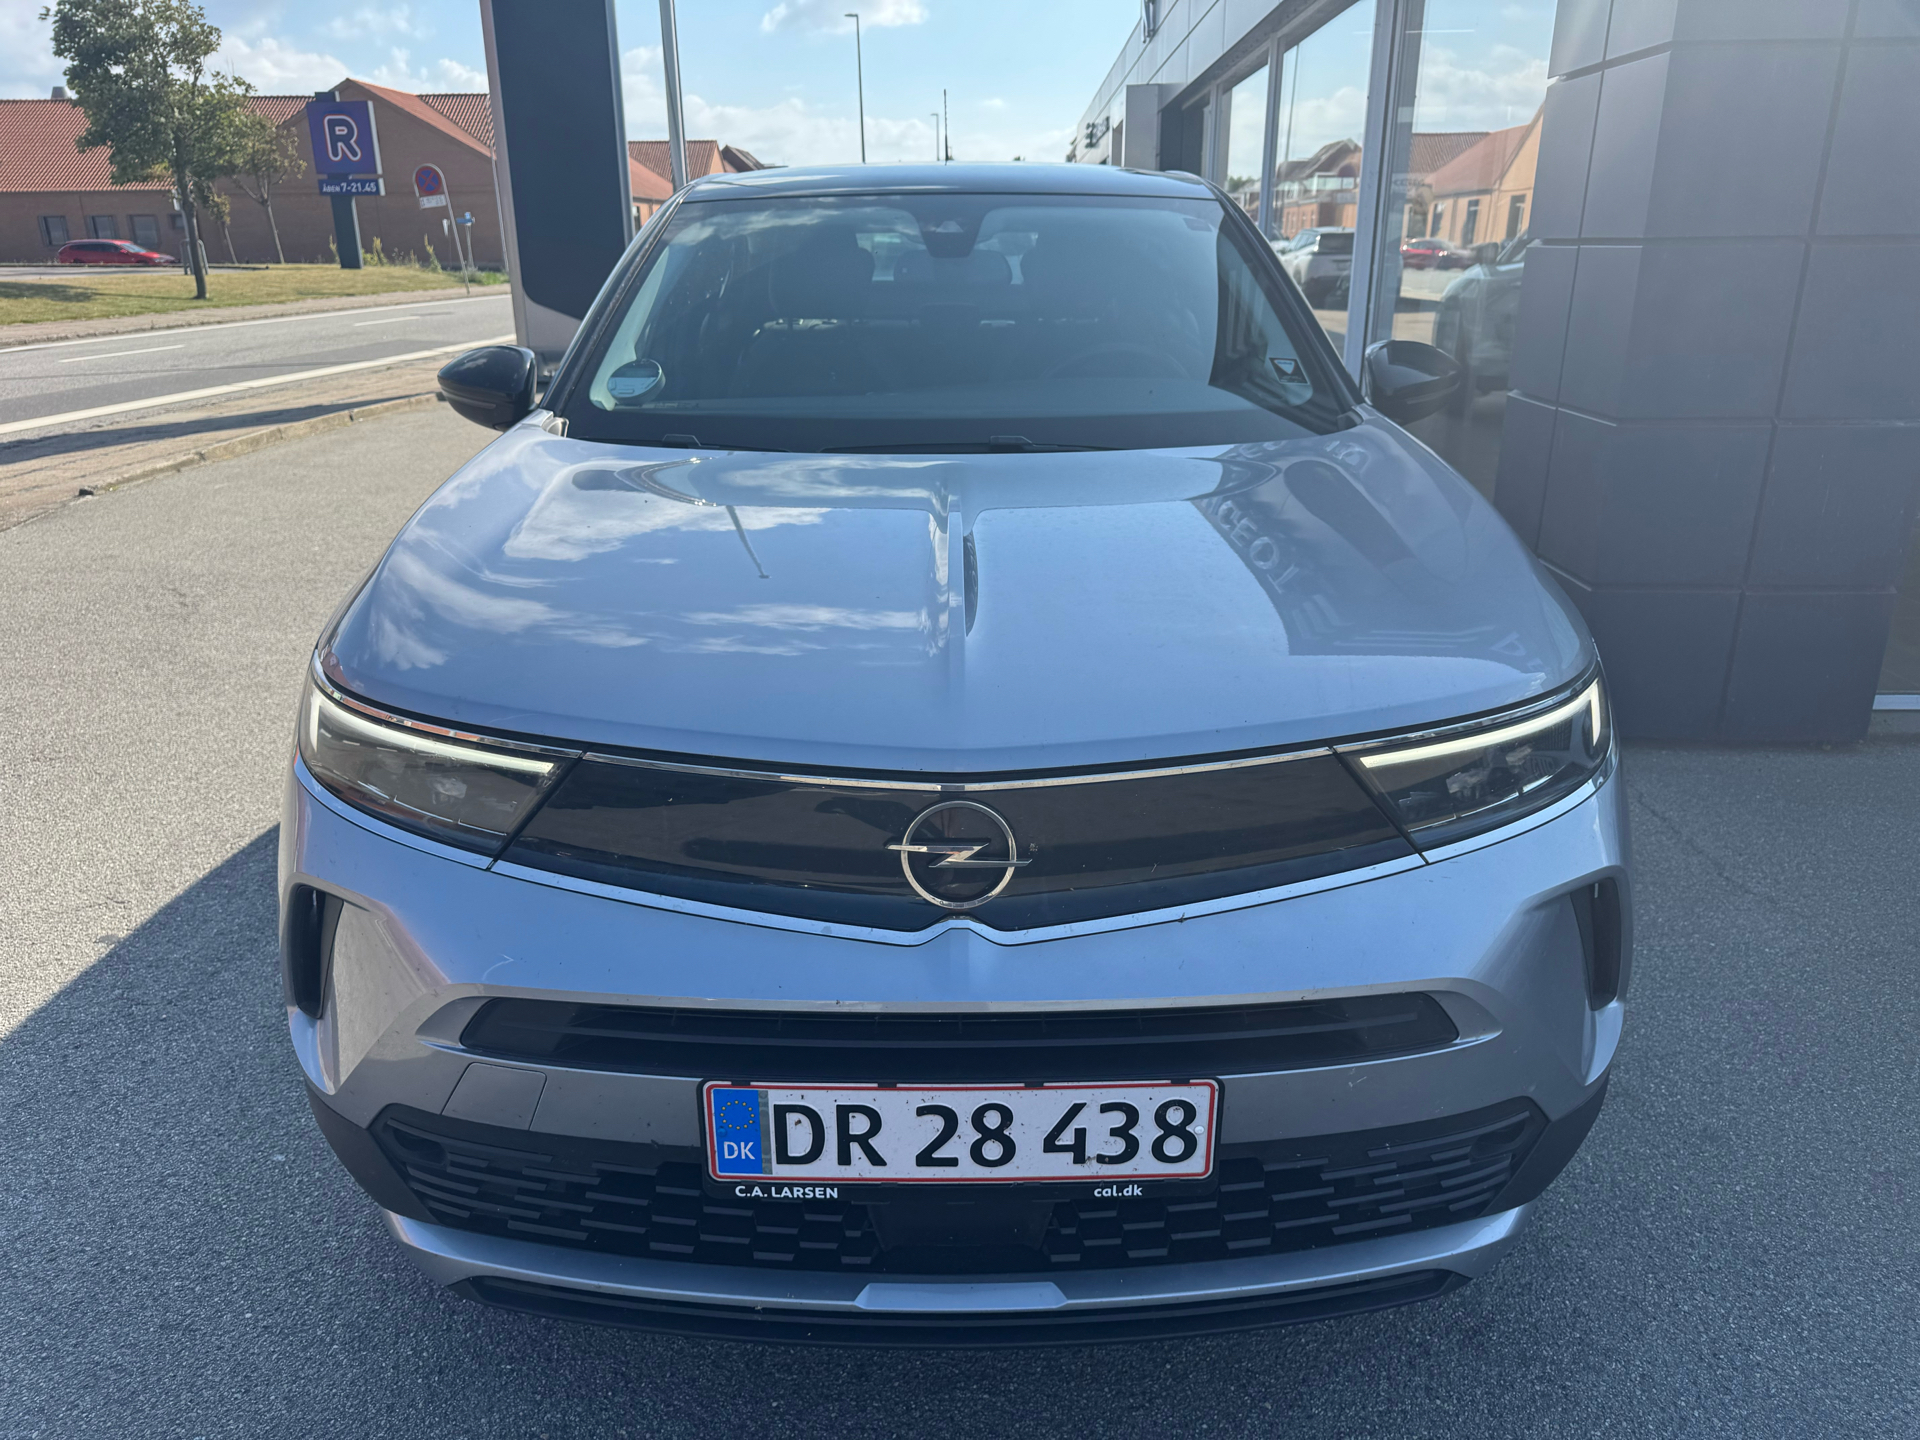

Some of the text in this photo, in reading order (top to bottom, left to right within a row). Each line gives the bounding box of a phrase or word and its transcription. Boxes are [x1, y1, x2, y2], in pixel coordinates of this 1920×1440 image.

[323, 114, 361, 161] R
[773, 1098, 1199, 1168] DR 28 438
[723, 1141, 755, 1160] DK
[735, 1185, 838, 1199] C.A. LARSEN
[1093, 1184, 1143, 1197] cal.dk
